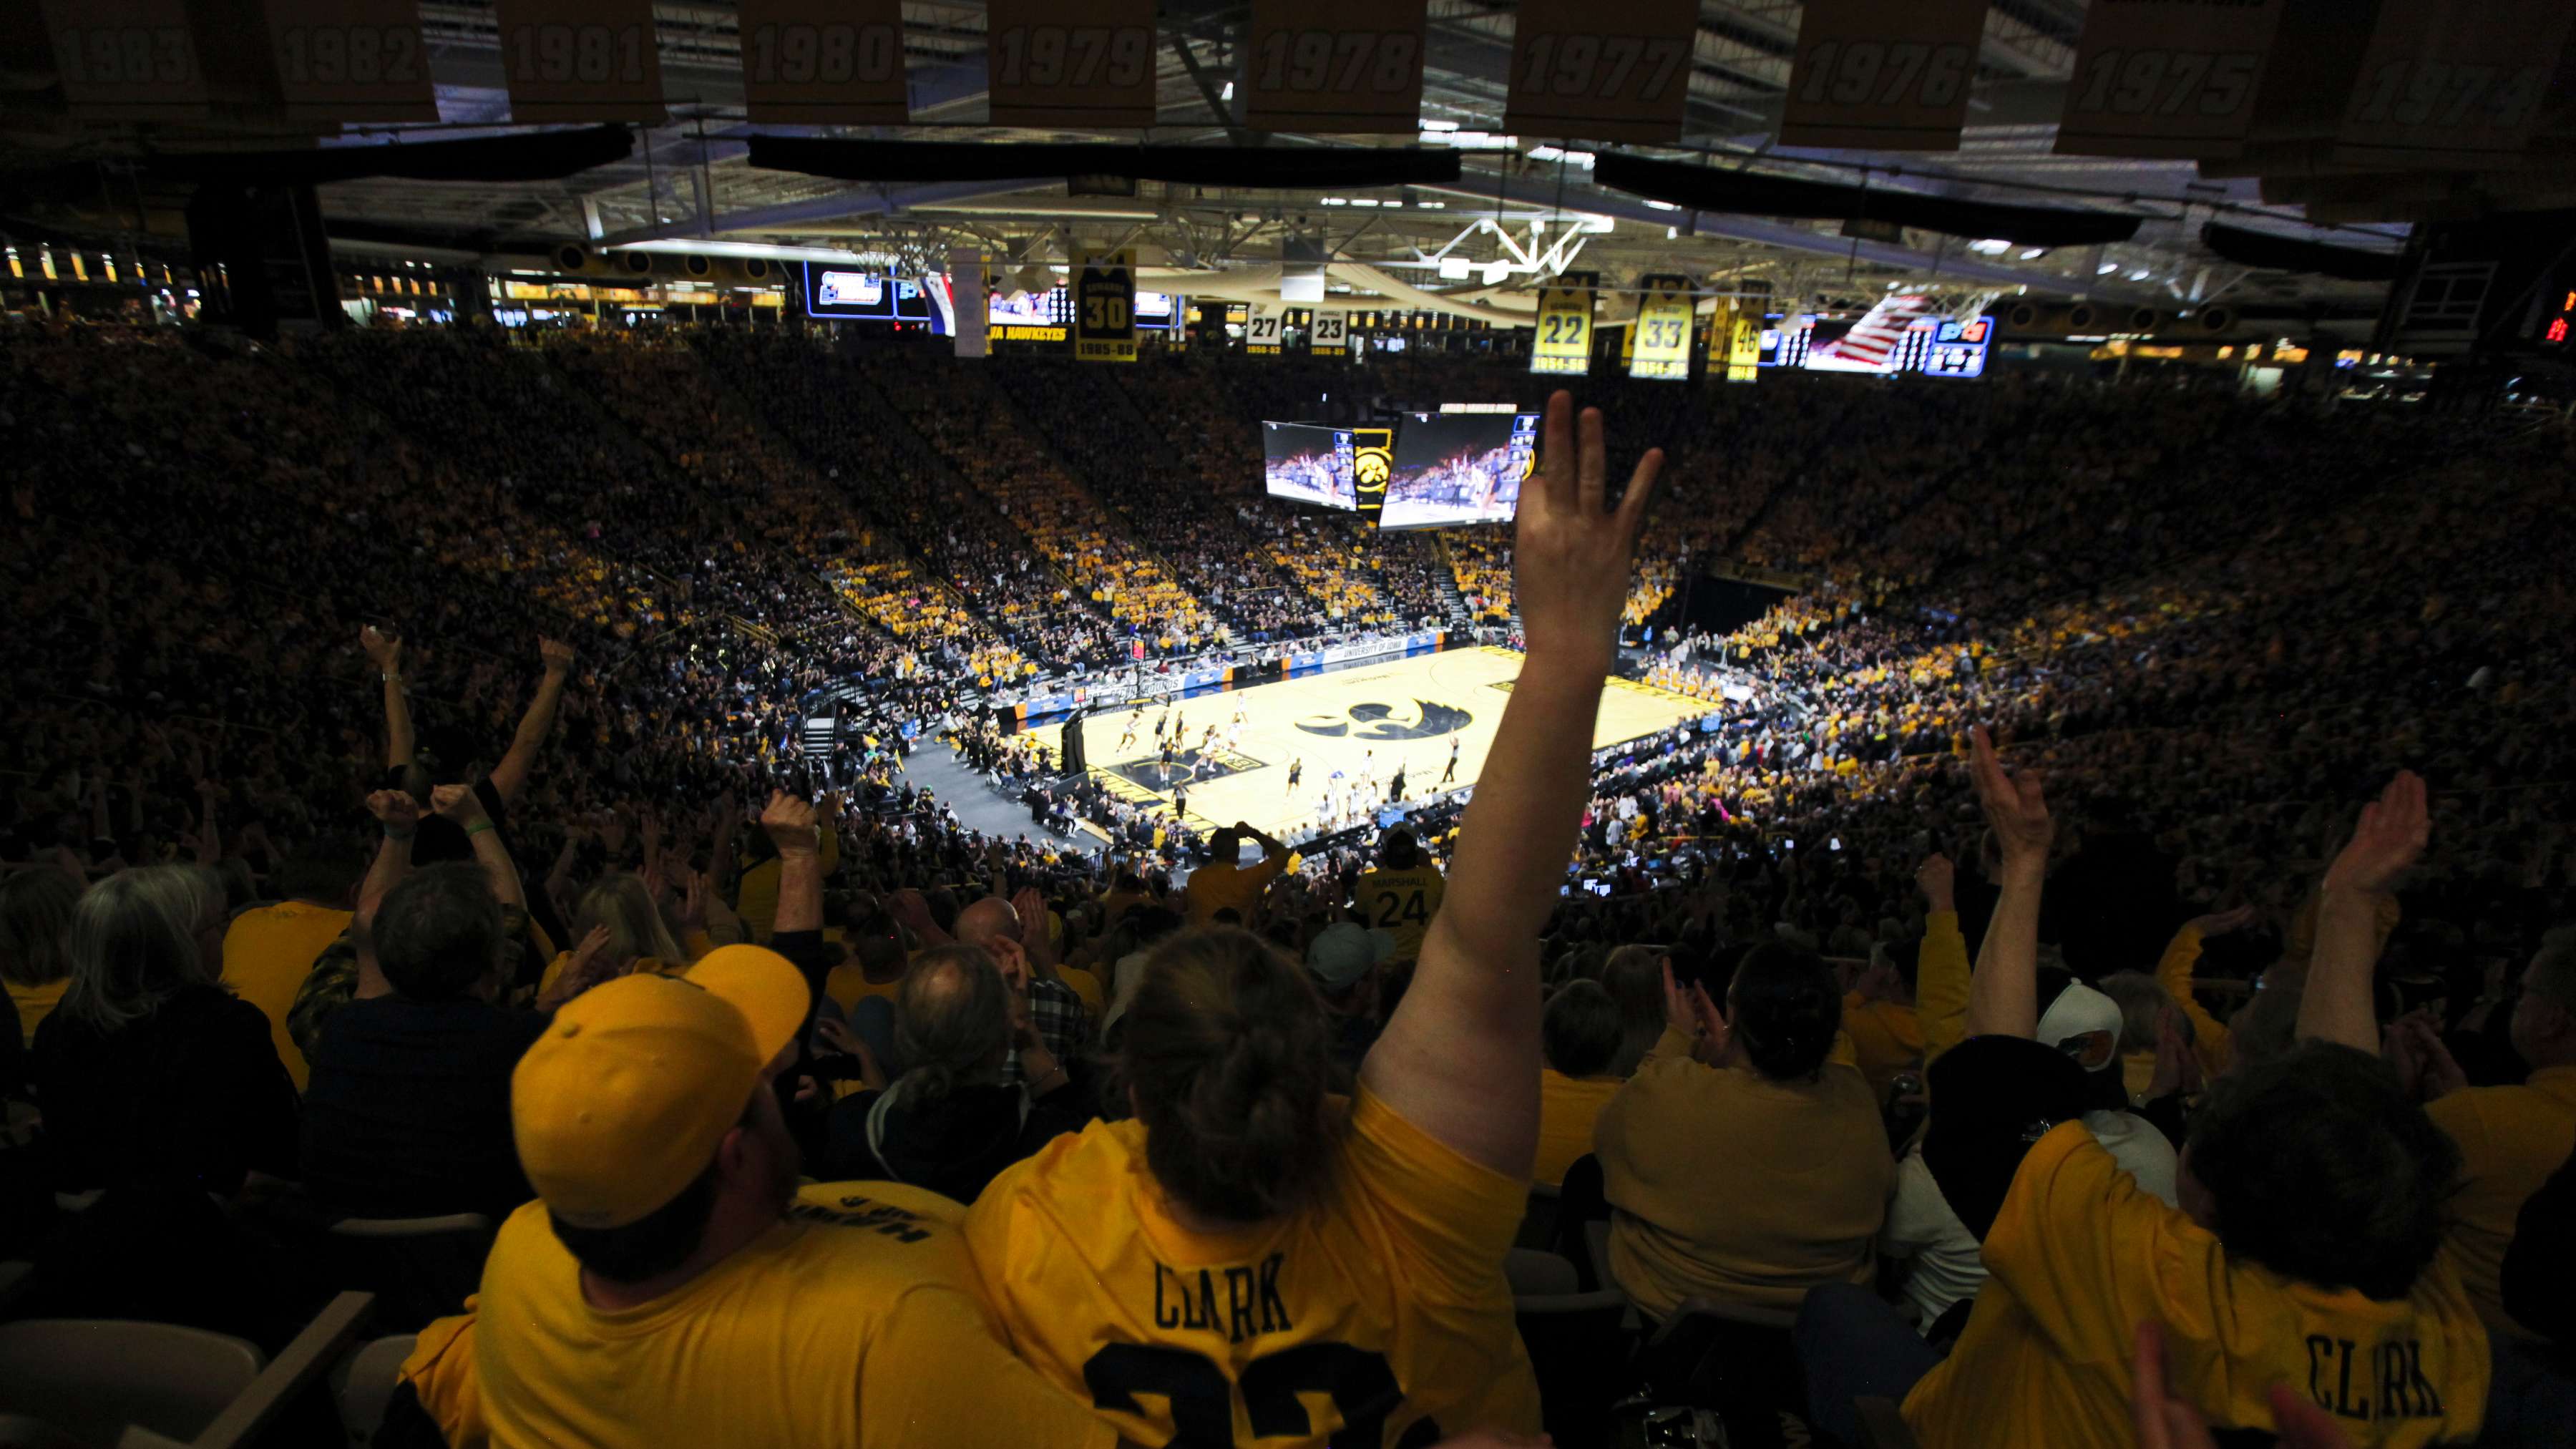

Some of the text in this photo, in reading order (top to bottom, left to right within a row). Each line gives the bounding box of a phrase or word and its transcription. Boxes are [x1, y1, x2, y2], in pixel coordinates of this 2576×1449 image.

[62, 27, 195, 84] 1983
[283, 24, 421, 84] 1982
[511, 23, 645, 84] 1981
[751, 22, 899, 84] 1980
[999, 24, 1151, 88] 1979
[1258, 29, 1420, 93] 1978
[1521, 32, 1692, 102] 1977
[1799, 39, 1972, 109] 1976
[2075, 47, 2262, 117] 1975
[2357, 60, 2546, 129] 1974
[1006, 326, 1067, 341] HAWKEYES
[1085, 296, 1127, 330] 30
[1252, 318, 1277, 337] 27
[1317, 319, 1342, 338] 23
[1544, 313, 1584, 345] 22
[1645, 319, 1684, 348] 33
[1344, 644, 1377, 658] UNIVERSITY
[1378, 641, 1387, 651] OF
[1373, 877, 1428, 888] MARSHALL
[1377, 890, 1429, 927] 24
[2306, 1335, 2443, 1420] CLRK
